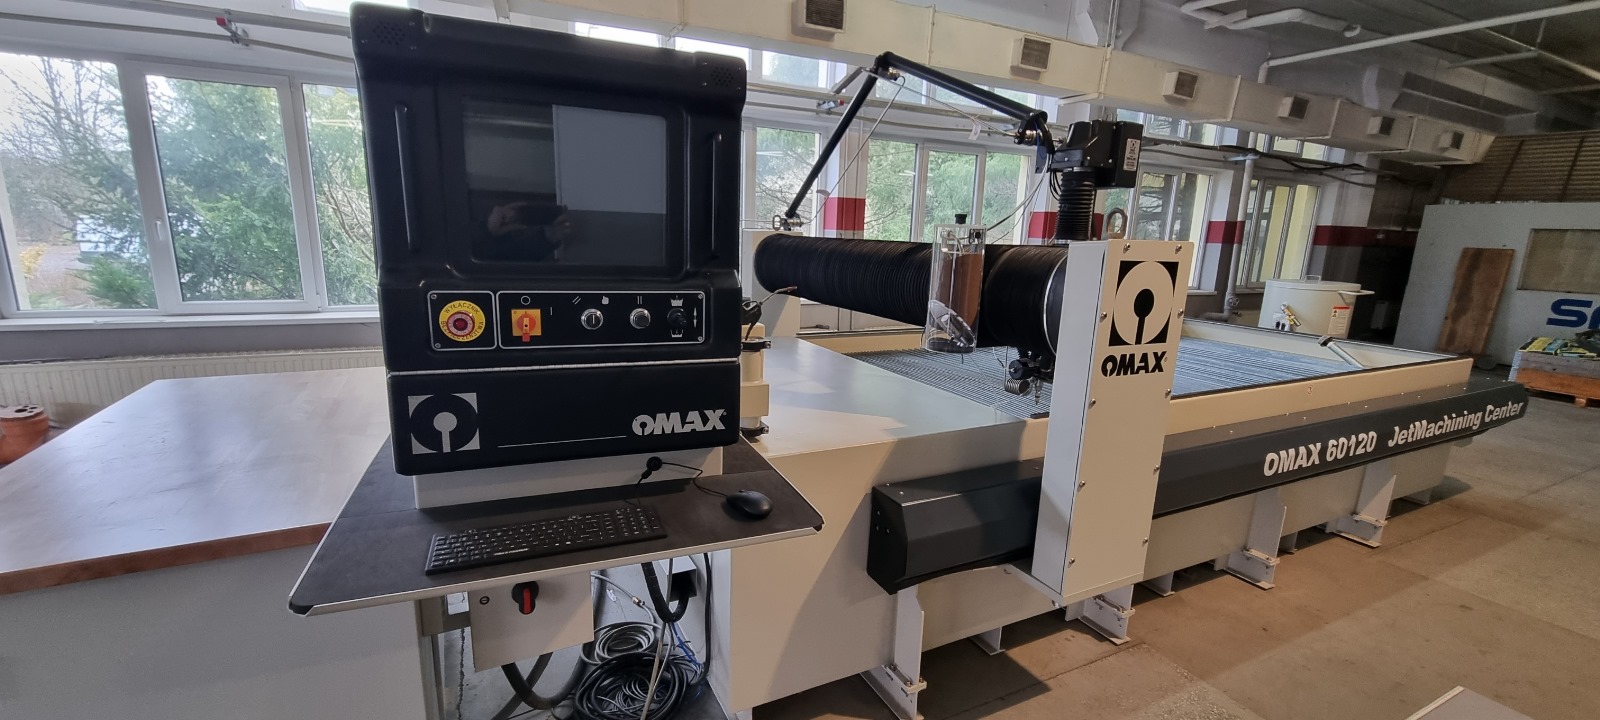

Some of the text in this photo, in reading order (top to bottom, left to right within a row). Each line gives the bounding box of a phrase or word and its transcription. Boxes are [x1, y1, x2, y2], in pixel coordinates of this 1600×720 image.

[1101, 351, 1167, 377] OMAX
[632, 409, 726, 436] OMAX
[1263, 401, 1525, 477] OMAX 60120 JetMachining Center
